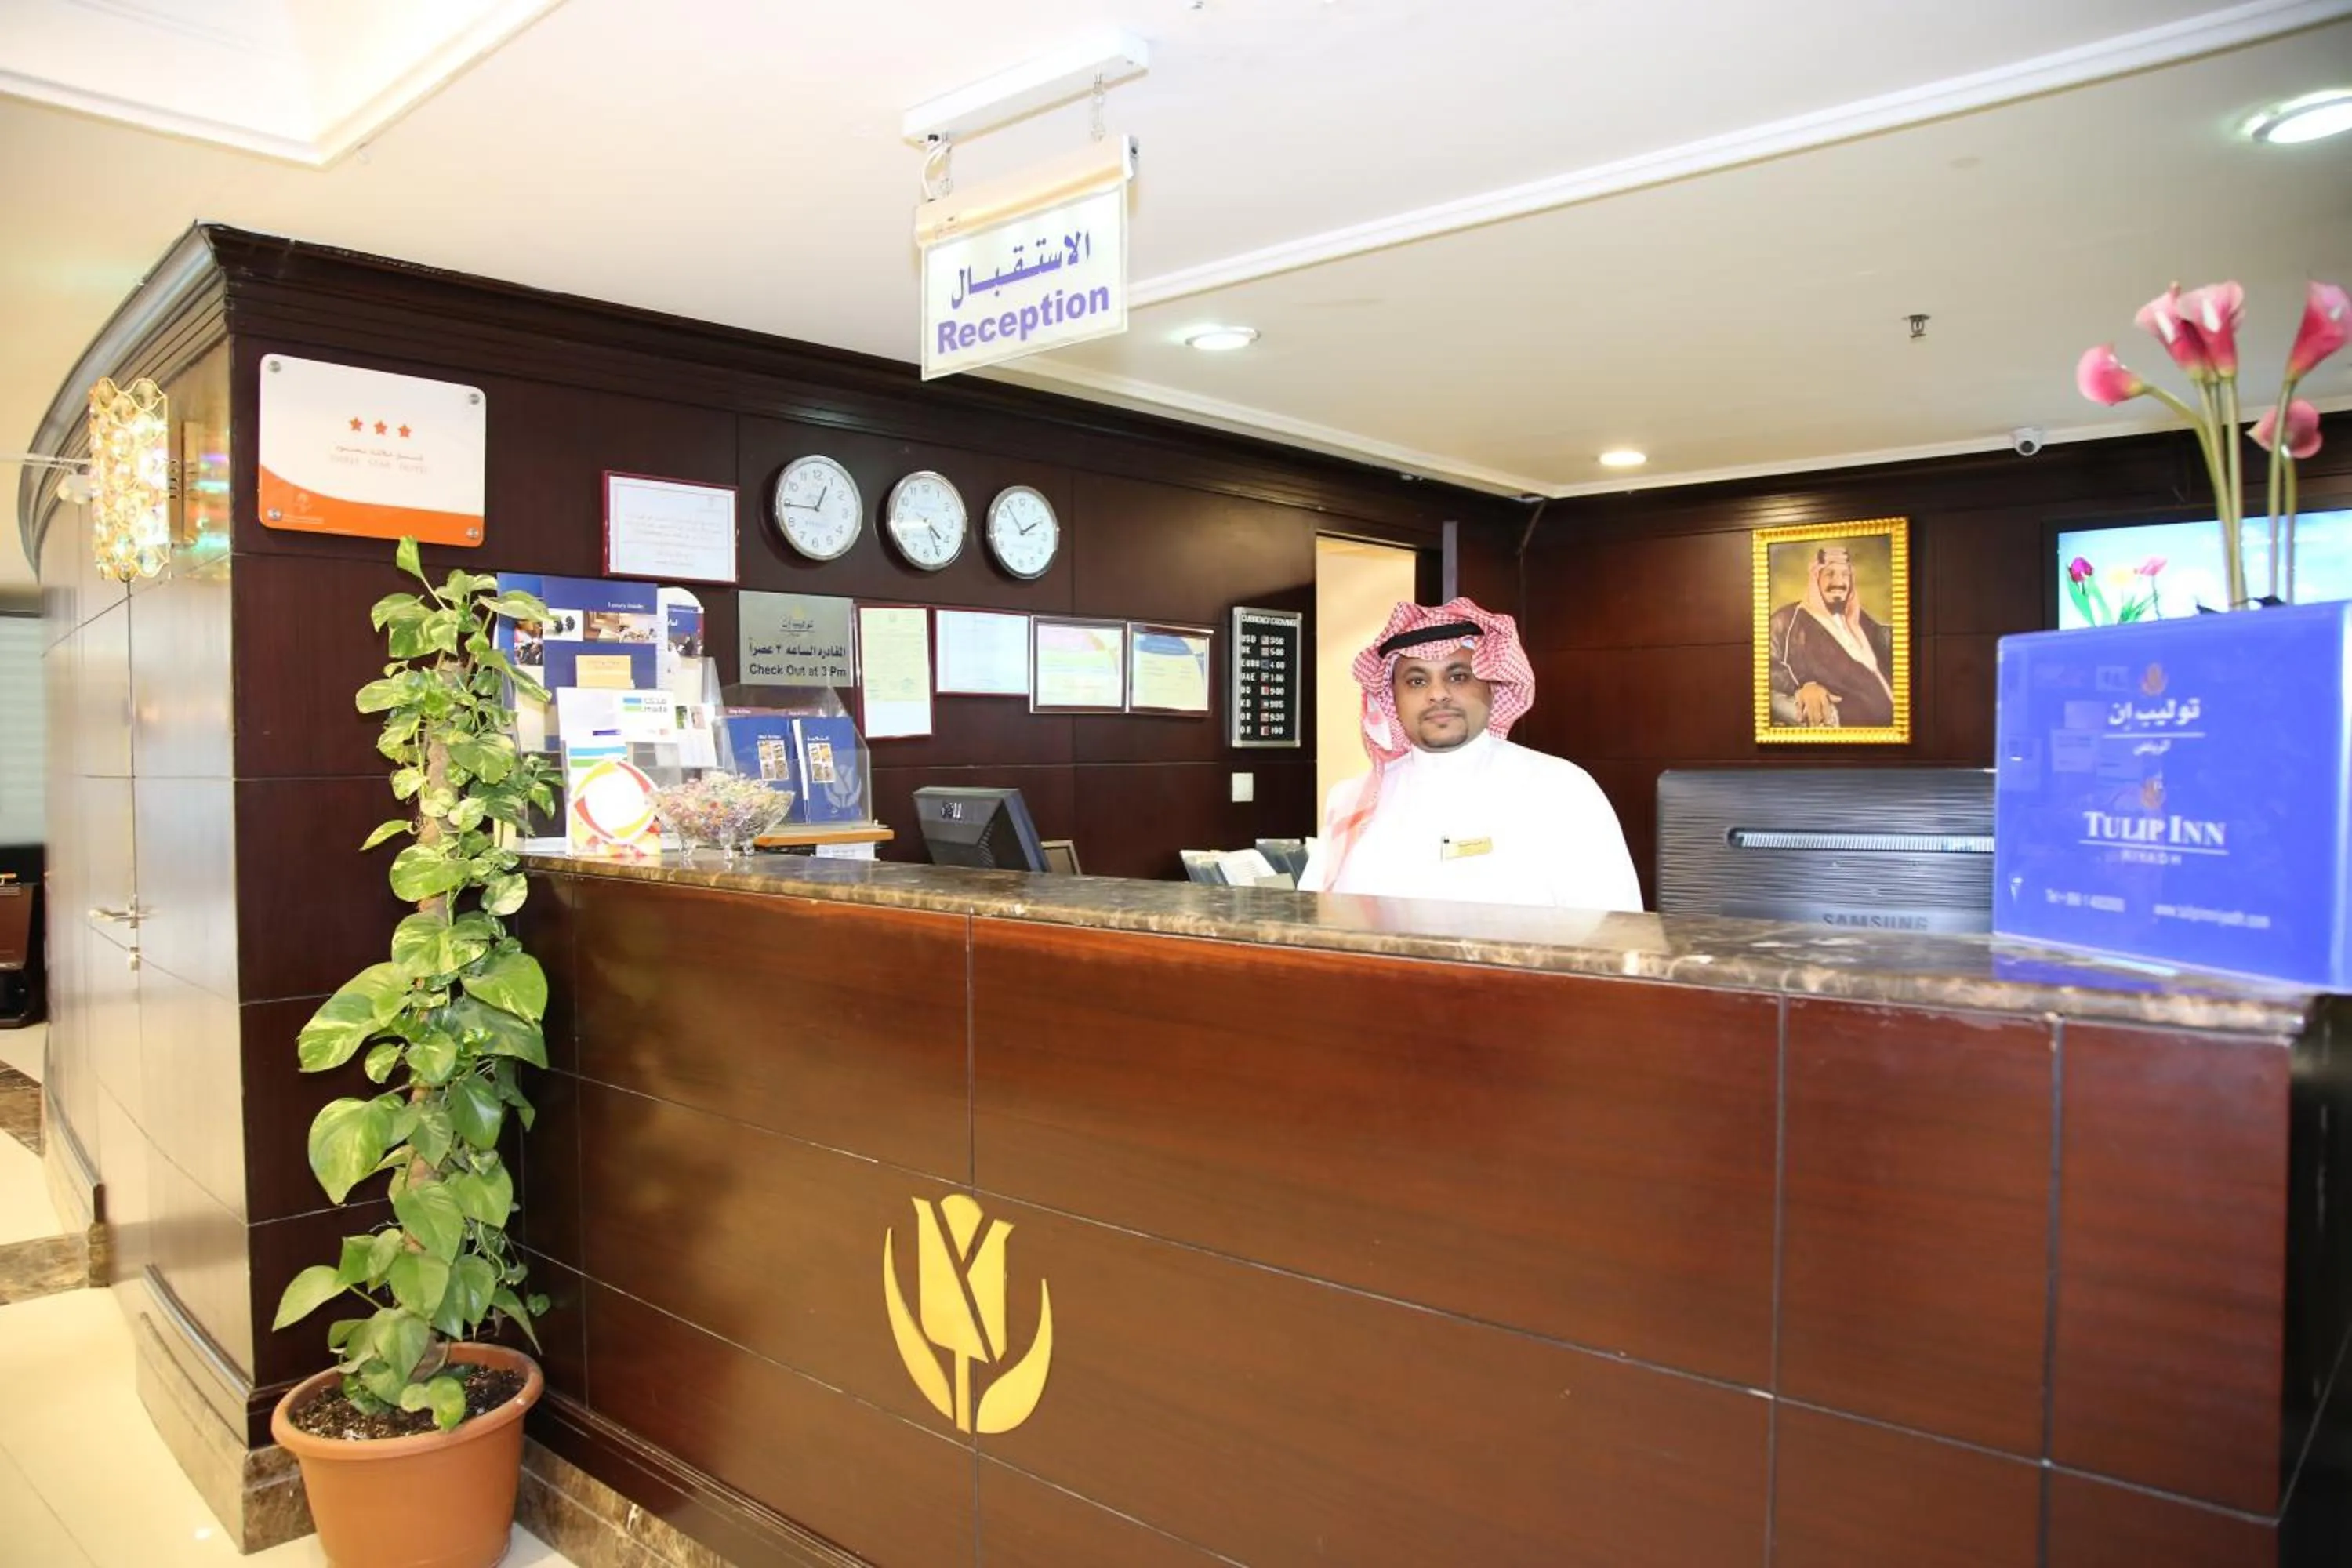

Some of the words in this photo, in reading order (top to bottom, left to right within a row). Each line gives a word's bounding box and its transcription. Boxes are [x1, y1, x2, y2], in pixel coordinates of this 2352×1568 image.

[950, 230, 1091, 310] الاستقبال
[937, 285, 1110, 354] Reception
[749, 663, 784, 676] Check
[786, 664, 805, 676] Out
[808, 666, 818, 677] at
[821, 666, 828, 677] 3
[829, 666, 847, 677] Pm
[2134, 697, 2201, 728] توليب
[2082, 810, 2165, 842] TULIP
[2168, 815, 2227, 847] INN
[1822, 913, 1929, 931] SAMSUNG
